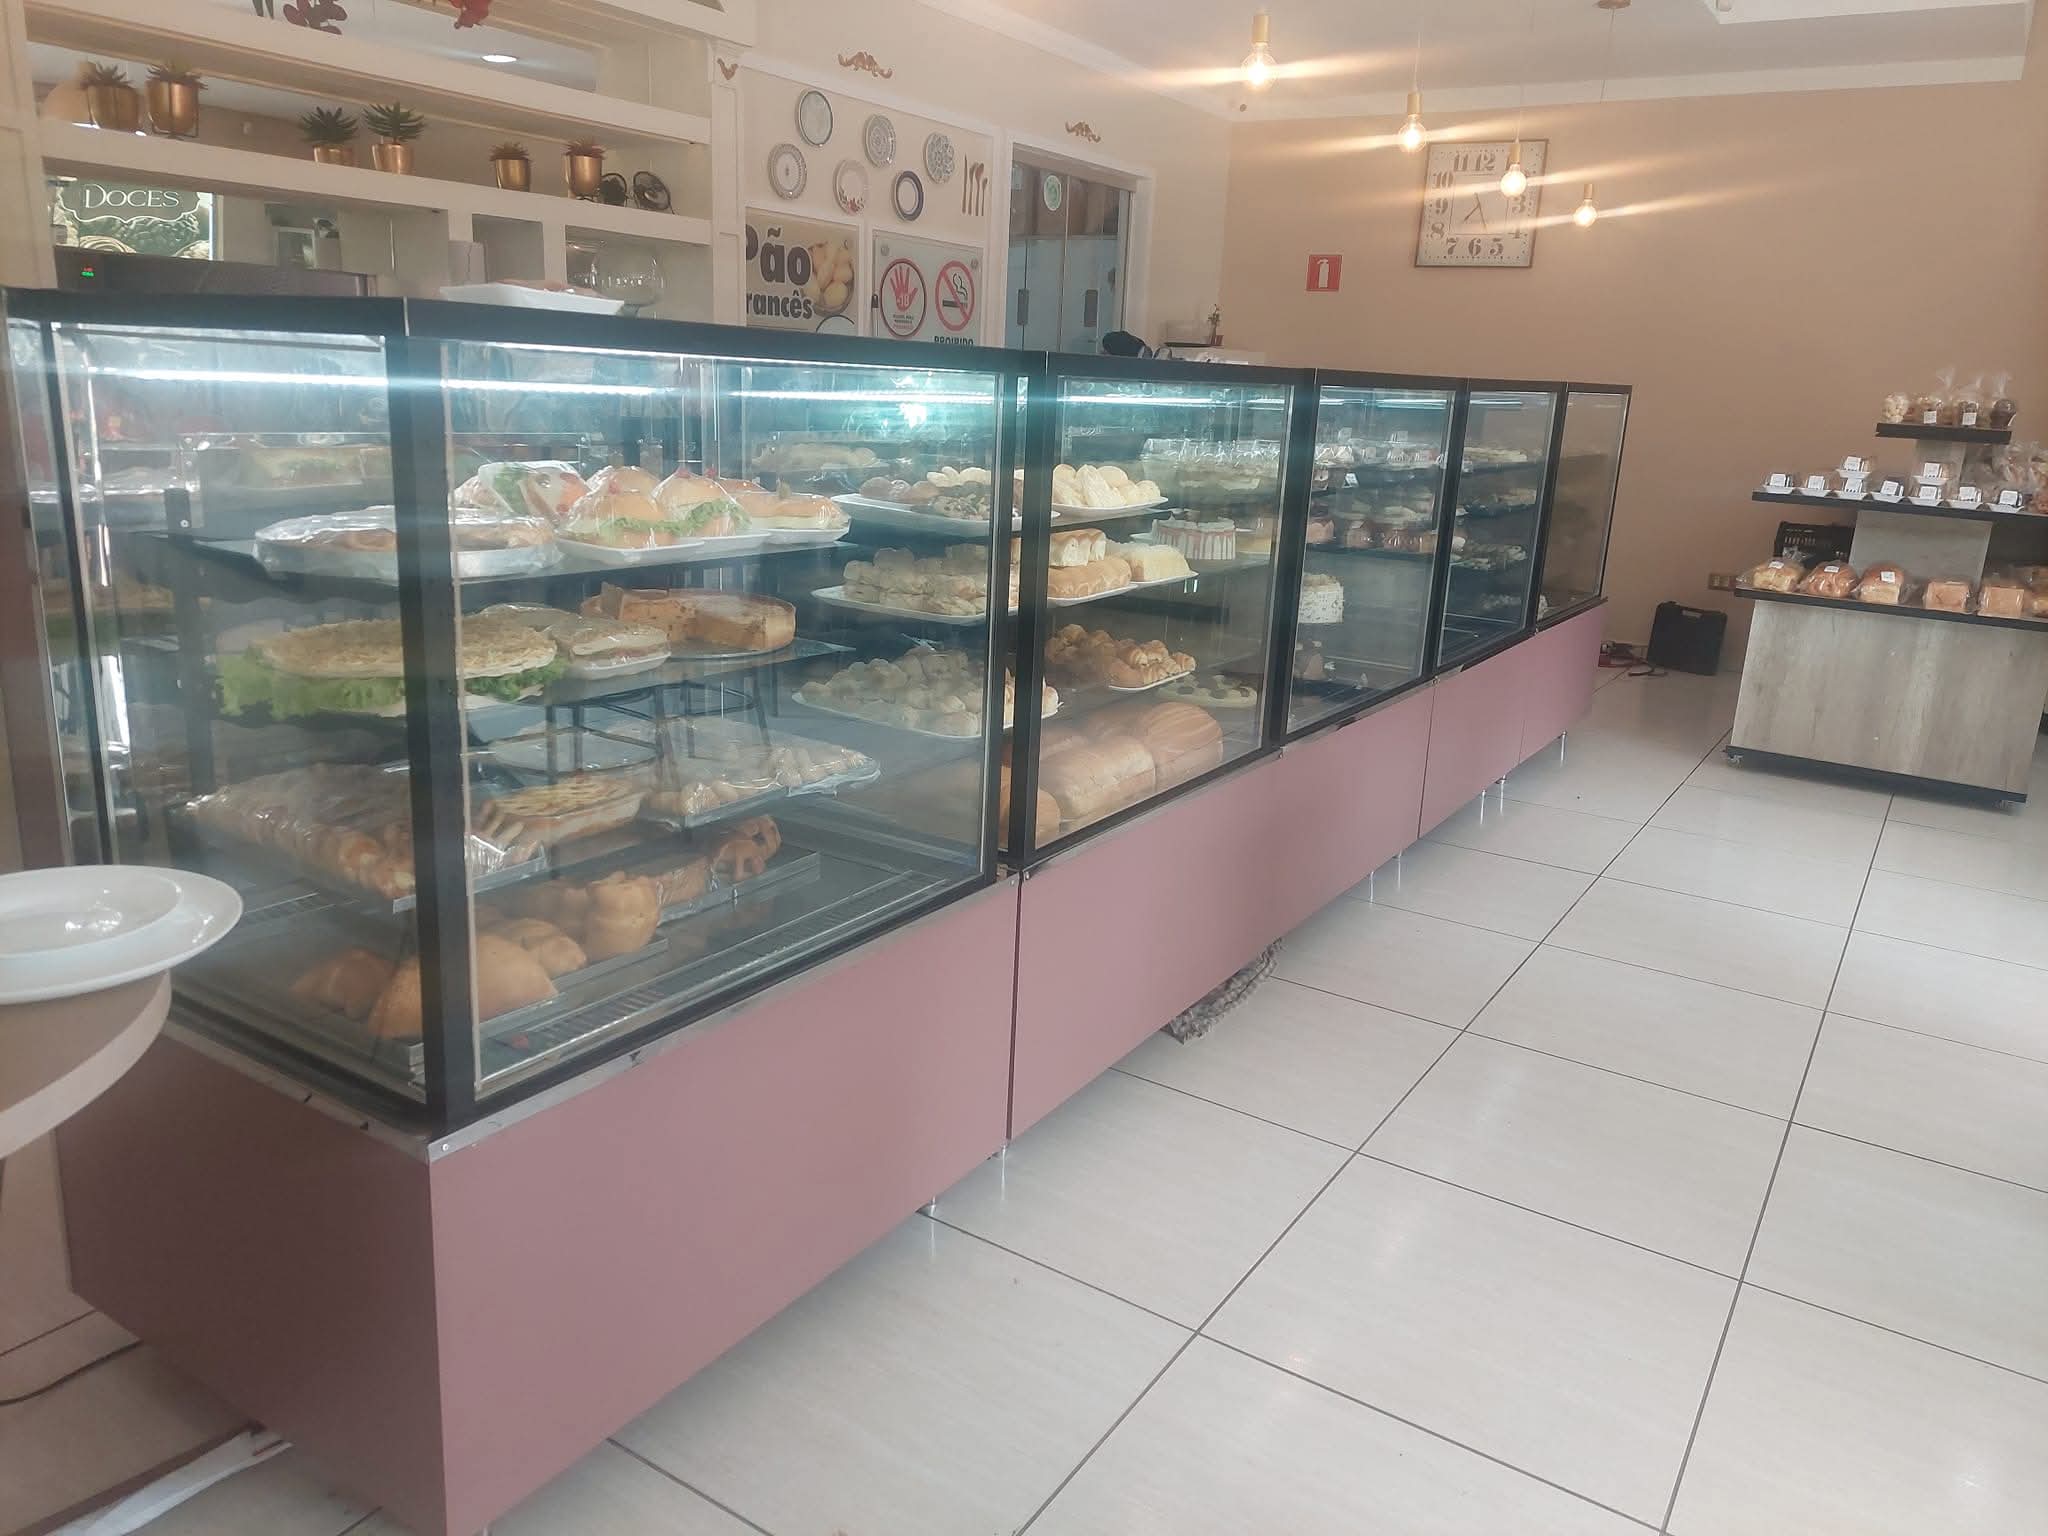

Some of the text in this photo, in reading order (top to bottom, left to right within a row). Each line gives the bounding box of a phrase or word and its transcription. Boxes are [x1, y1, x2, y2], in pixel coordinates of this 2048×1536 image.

[1475, 152, 1496, 172] 12
[83, 184, 180, 209] DOCES
[1430, 222, 1445, 239] 8
[1446, 237, 1459, 256] 7
[1468, 237, 1482, 256] 6
[1489, 237, 1504, 256] 5
[746, 290, 813, 320] rancês
